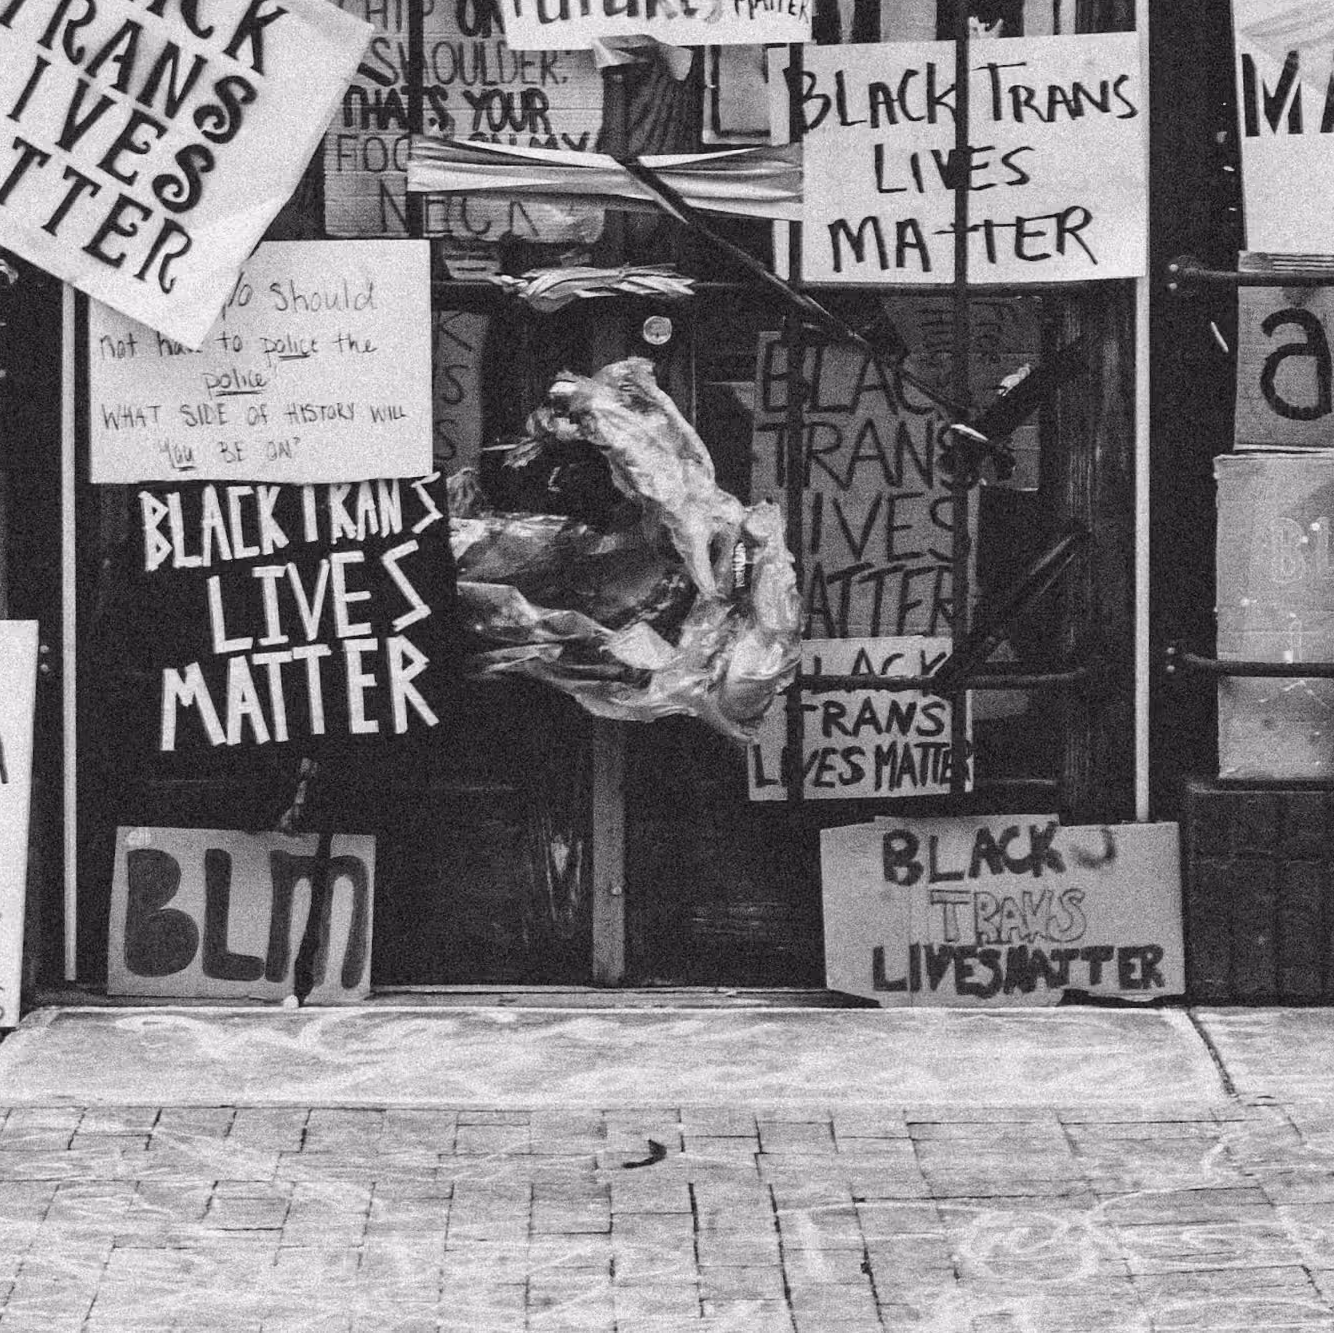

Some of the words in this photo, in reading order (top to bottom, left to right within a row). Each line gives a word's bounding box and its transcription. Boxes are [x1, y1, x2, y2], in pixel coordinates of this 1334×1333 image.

[783, 62, 957, 135] BLACK
[972, 62, 1139, 123] TRANS
[874, 143, 1035, 194] LIVES
[827, 205, 1099, 273] MATTER
[138, 483, 289, 572] BLACK
[301, 470, 444, 545] TRANS
[207, 539, 432, 654] LIVES
[160, 635, 441, 751] MATTER
[883, 822, 1065, 886] BLACK
[929, 888, 1087, 944] TRANS
[873, 943, 1003, 998] LIVES
[1002, 943, 1166, 995] MATTER
